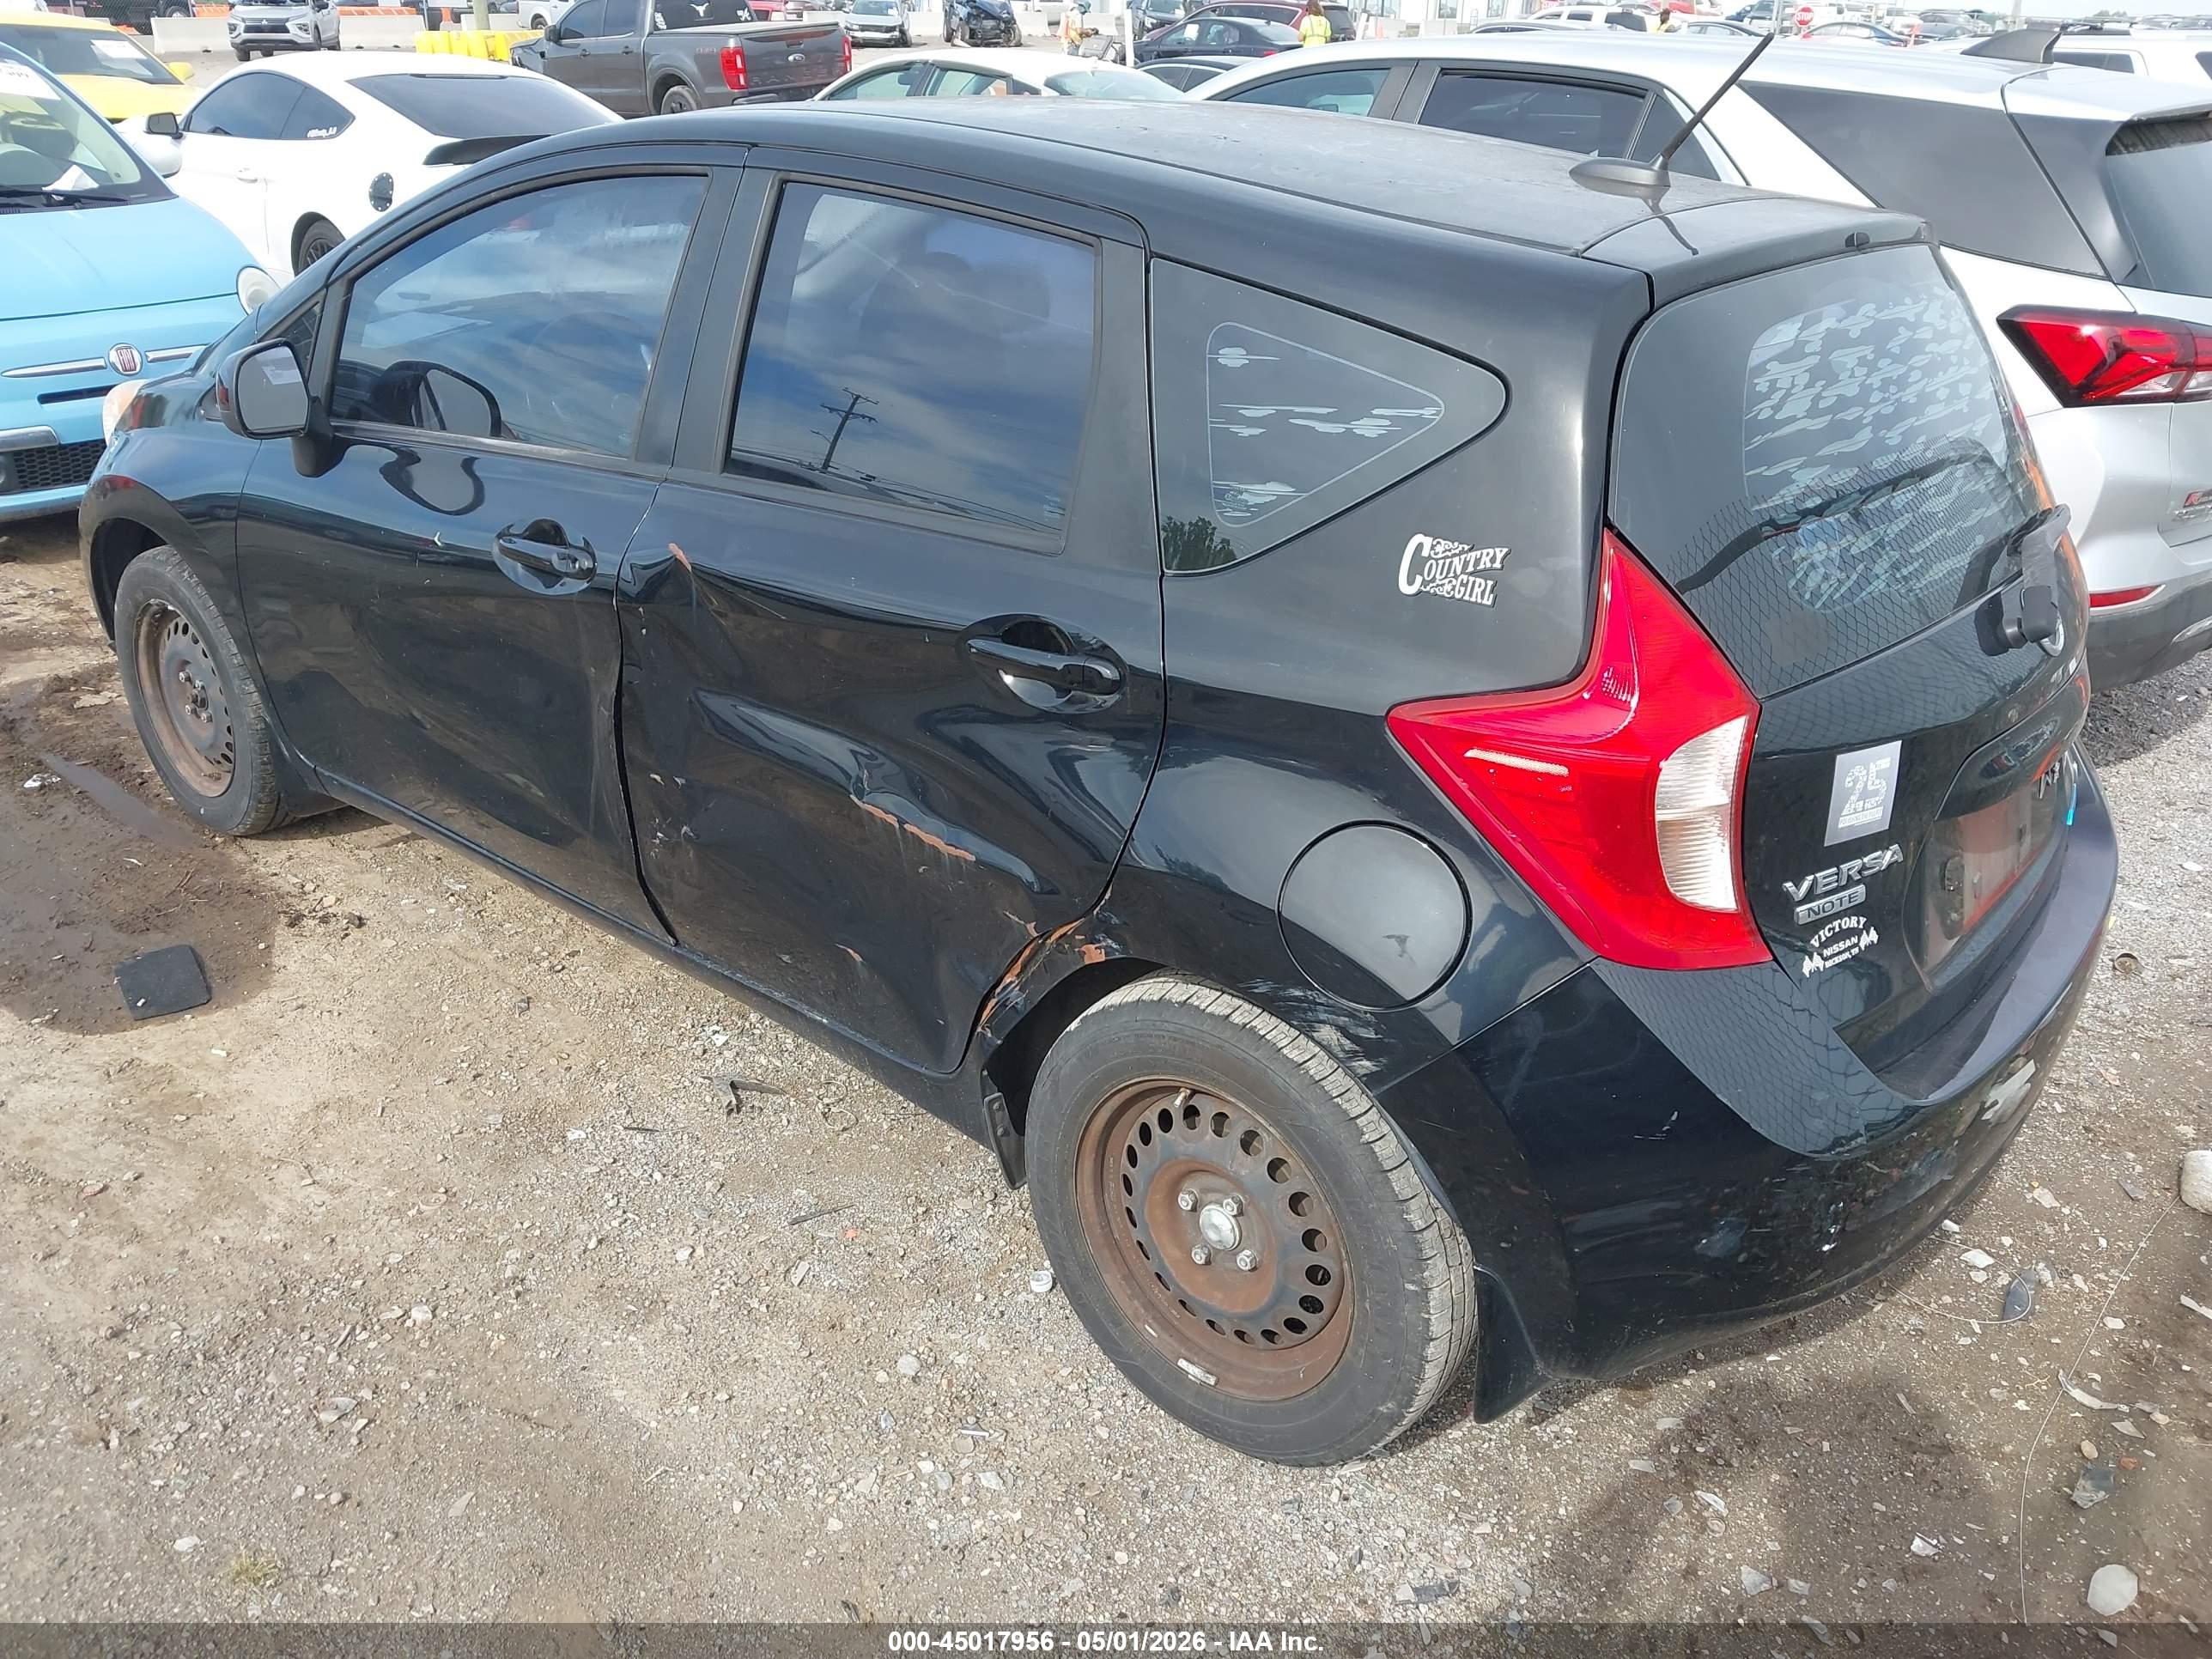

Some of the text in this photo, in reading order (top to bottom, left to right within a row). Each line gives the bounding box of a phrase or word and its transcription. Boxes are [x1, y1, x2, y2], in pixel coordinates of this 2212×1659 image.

[1796, 12, 1814, 21] STOP
[1398, 532, 1510, 595] COUNTRY
[1455, 574, 1496, 606] GIRL
[1782, 843, 1904, 902] VERSA
[1806, 891, 1860, 919] NOTE
[1810, 915, 1868, 948] VICTORY
[1822, 935, 1859, 958] NISSAN
